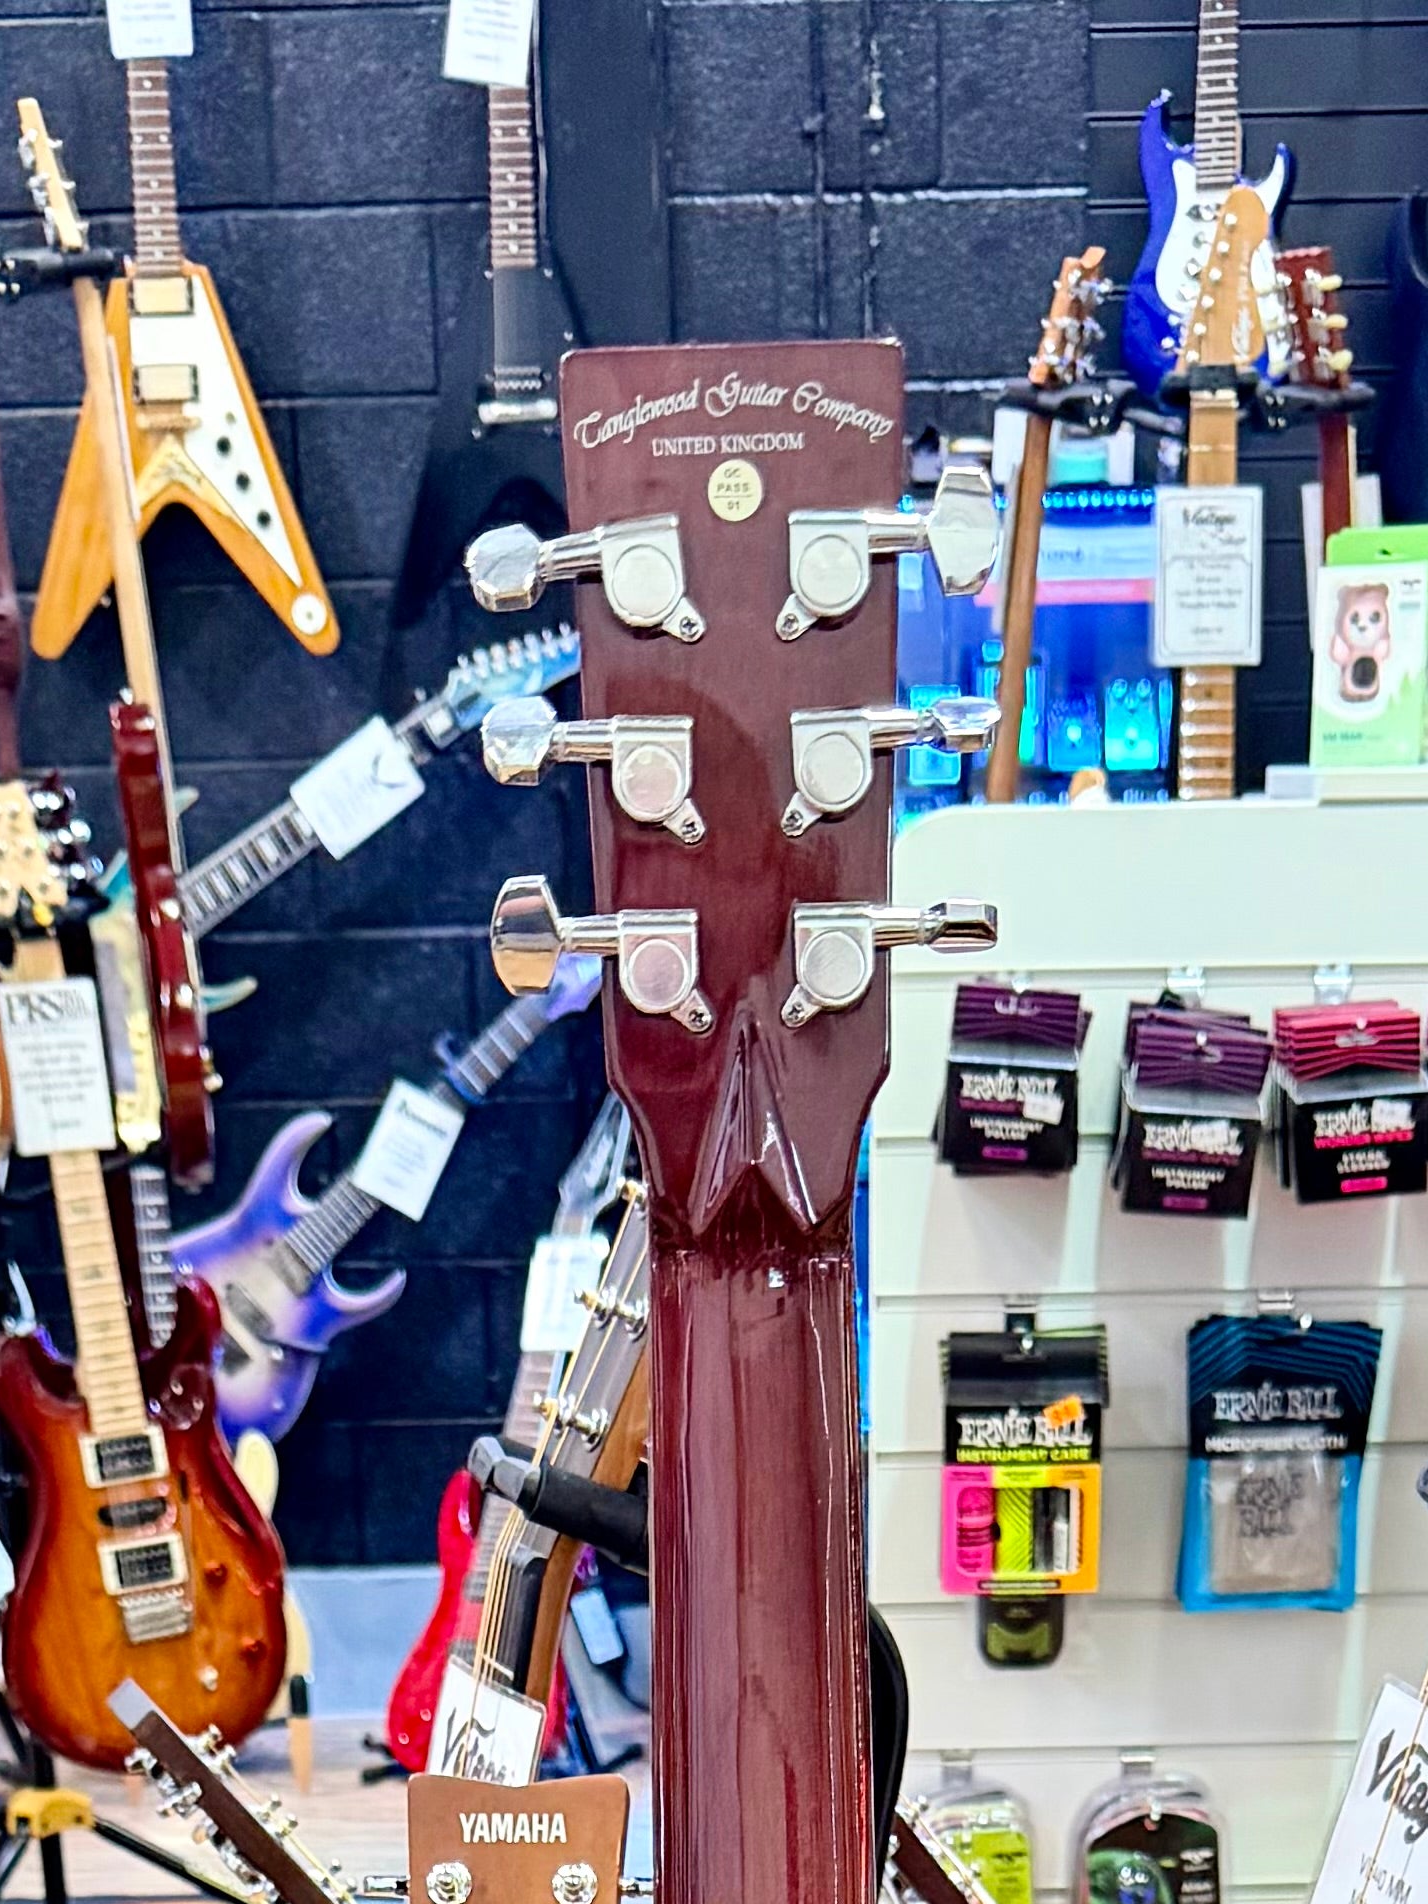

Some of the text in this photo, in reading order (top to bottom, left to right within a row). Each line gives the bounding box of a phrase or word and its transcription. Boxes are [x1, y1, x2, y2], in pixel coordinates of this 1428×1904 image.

[574, 372, 894, 449] Tanglewood Guitar Company
[652, 431, 806, 457] UNITED KINGDOM
[717, 482, 749, 493] PASS
[1212, 1381, 1344, 1422] ERNIE BALL
[956, 1407, 1032, 1448] ERNIE
[458, 1812, 568, 1844] YAMAHA
